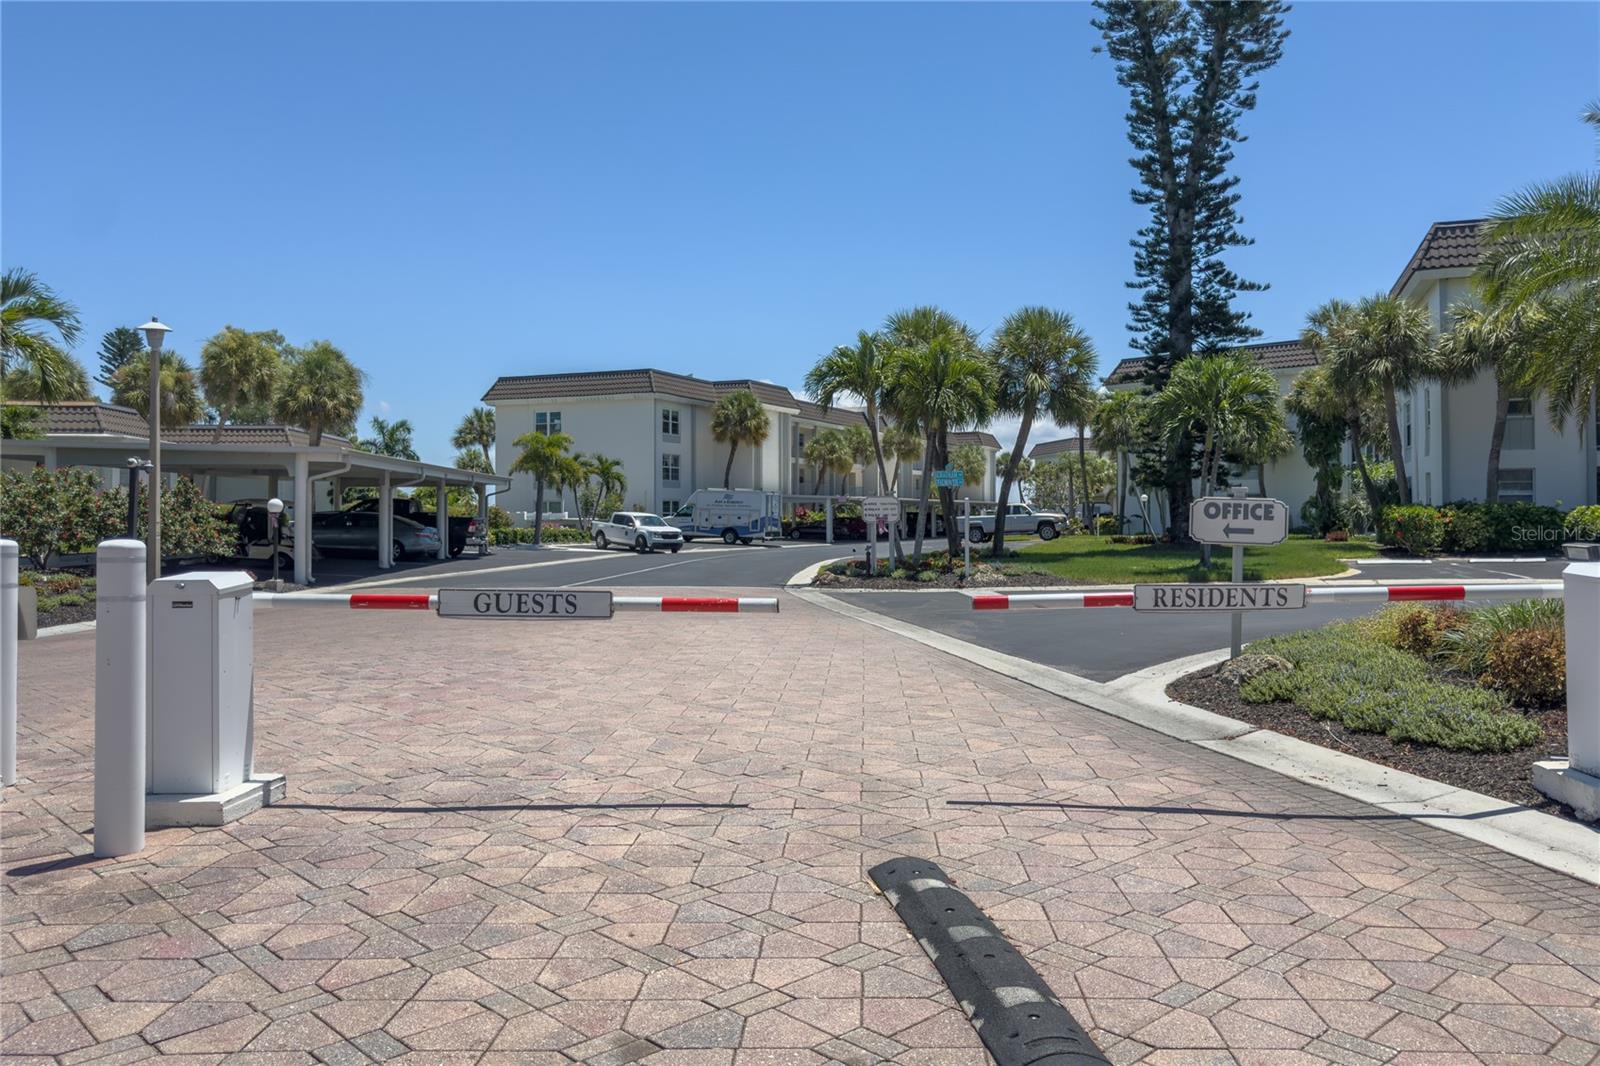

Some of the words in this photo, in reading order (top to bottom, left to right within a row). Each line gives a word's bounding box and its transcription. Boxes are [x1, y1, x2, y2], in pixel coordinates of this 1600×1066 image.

[1203, 502, 1275, 521] OFFICE
[473, 593, 577, 615] GUESTS
[1153, 587, 1288, 608] RESIDENTS
